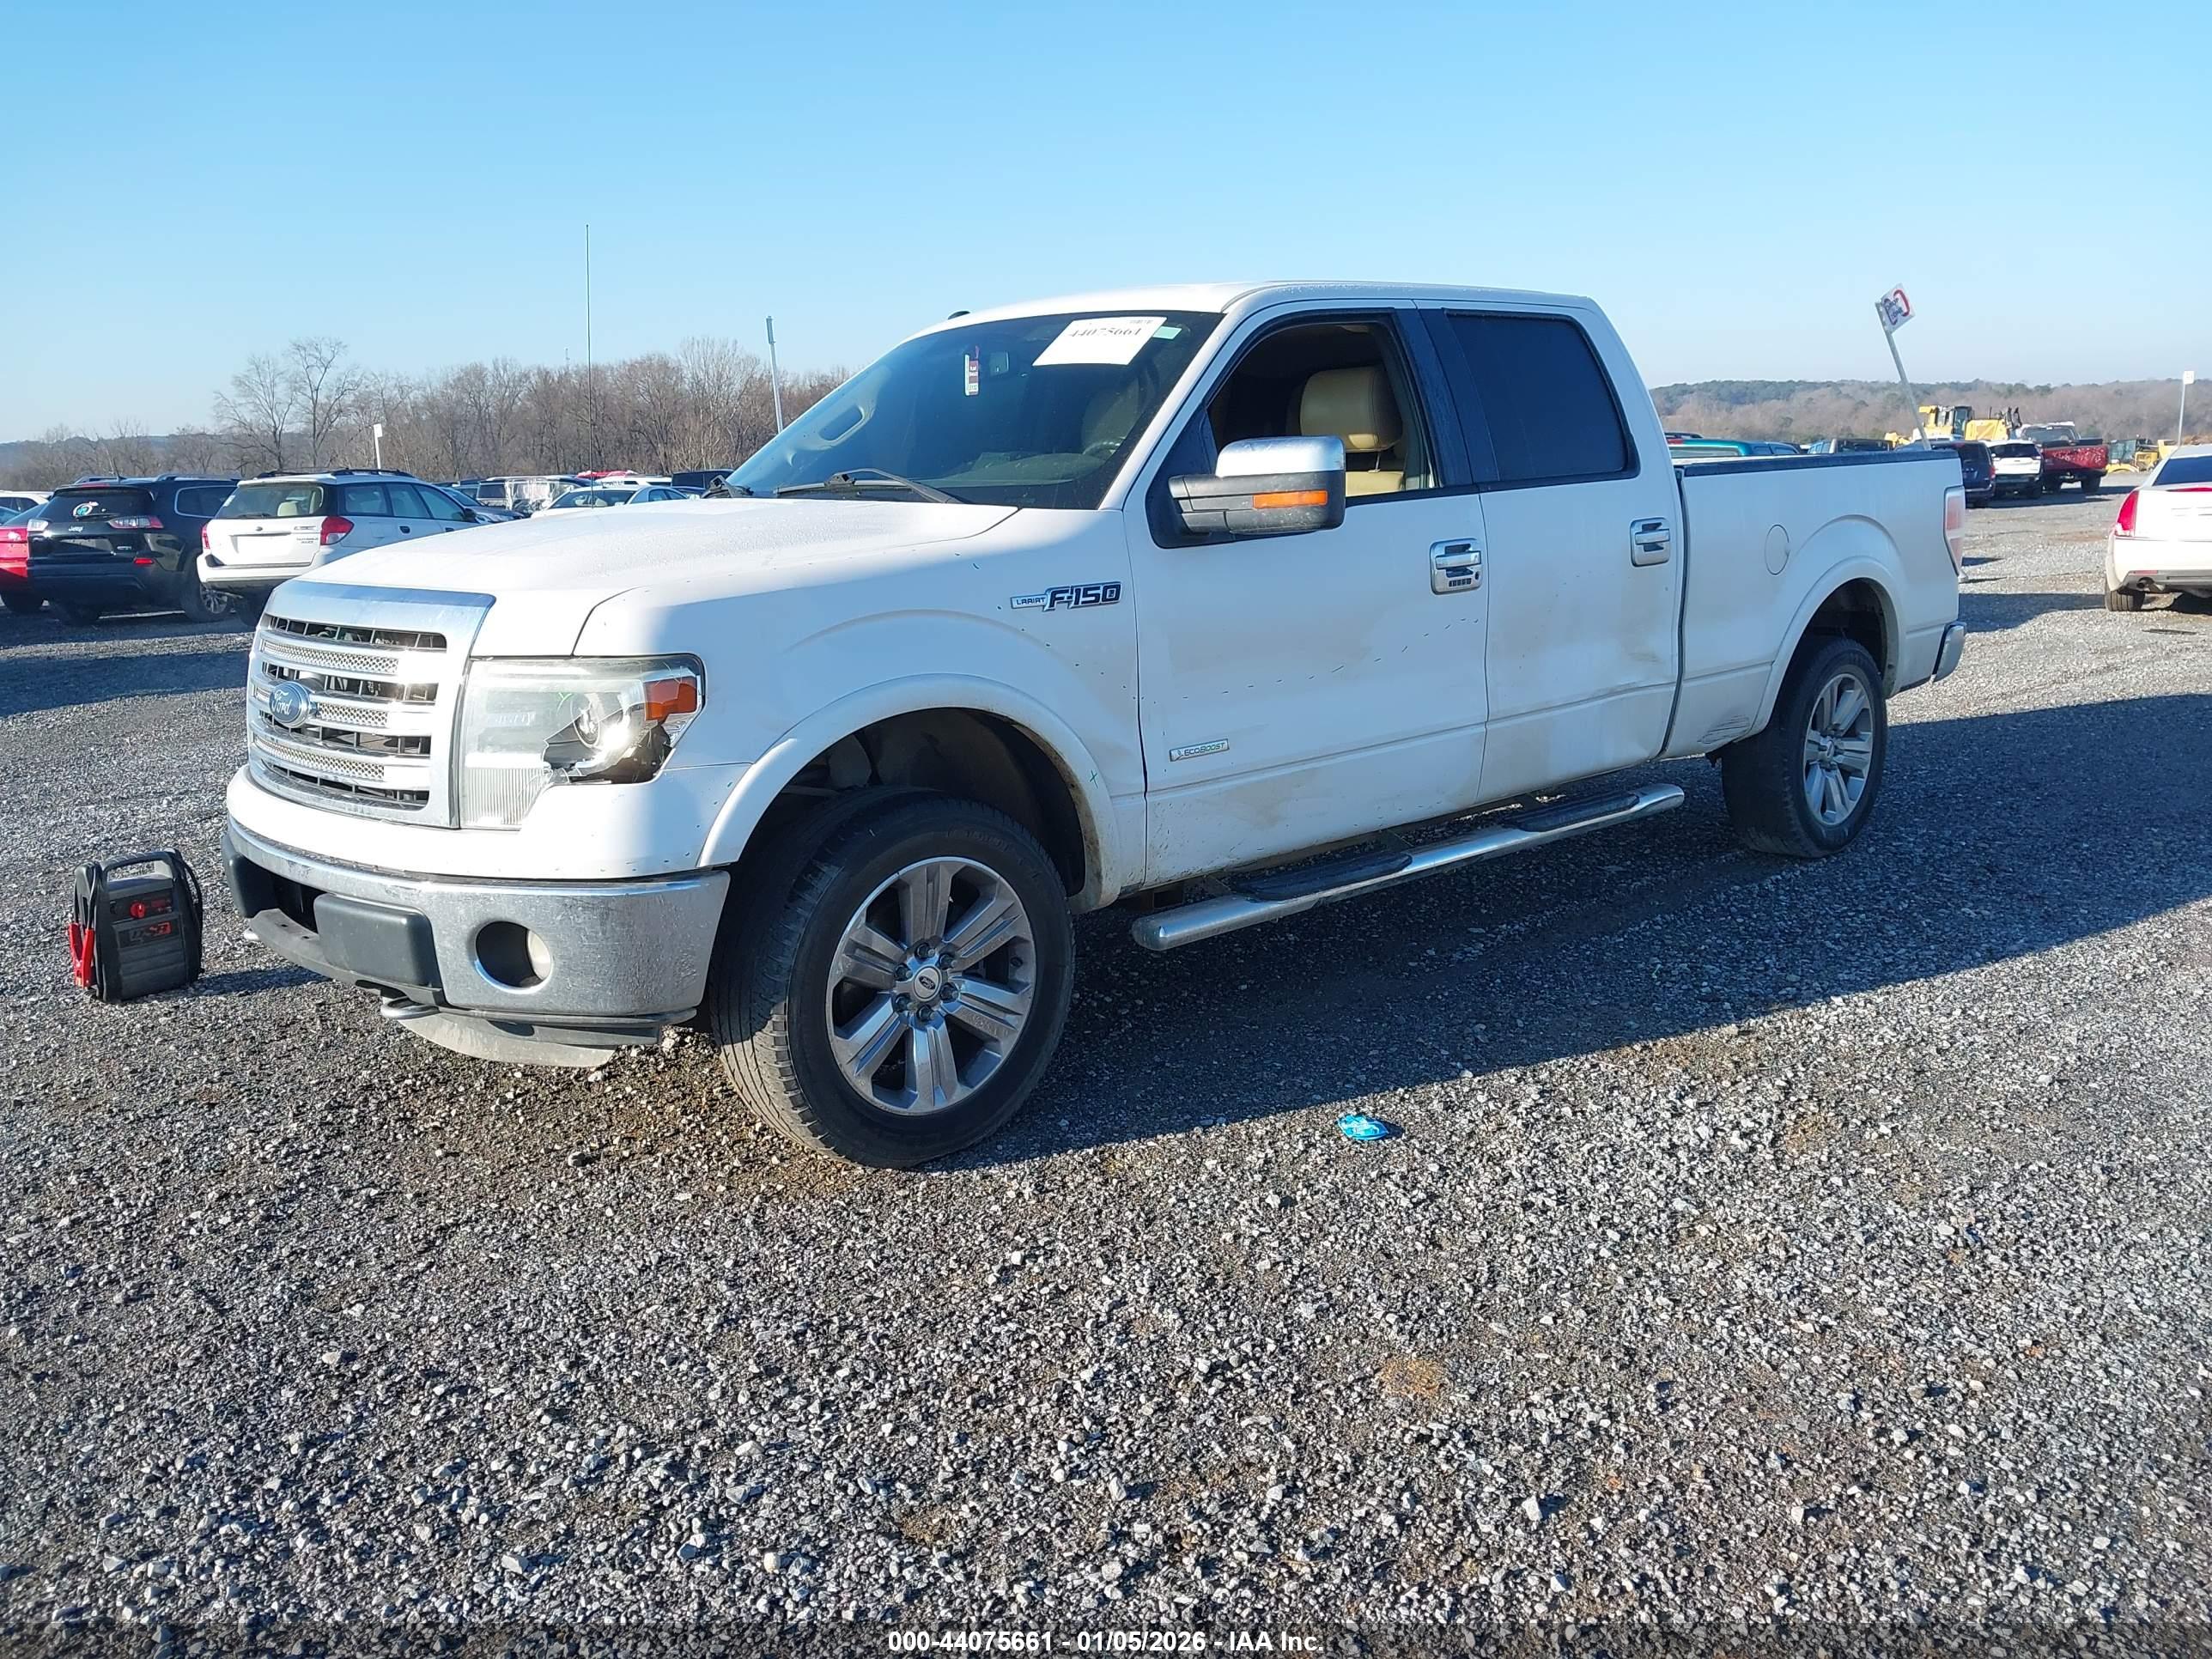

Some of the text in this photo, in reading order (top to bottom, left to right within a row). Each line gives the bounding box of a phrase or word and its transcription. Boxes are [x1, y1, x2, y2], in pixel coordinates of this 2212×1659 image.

[1016, 583, 1121, 609] LARIAT F-150
[271, 689, 293, 715] Ford
